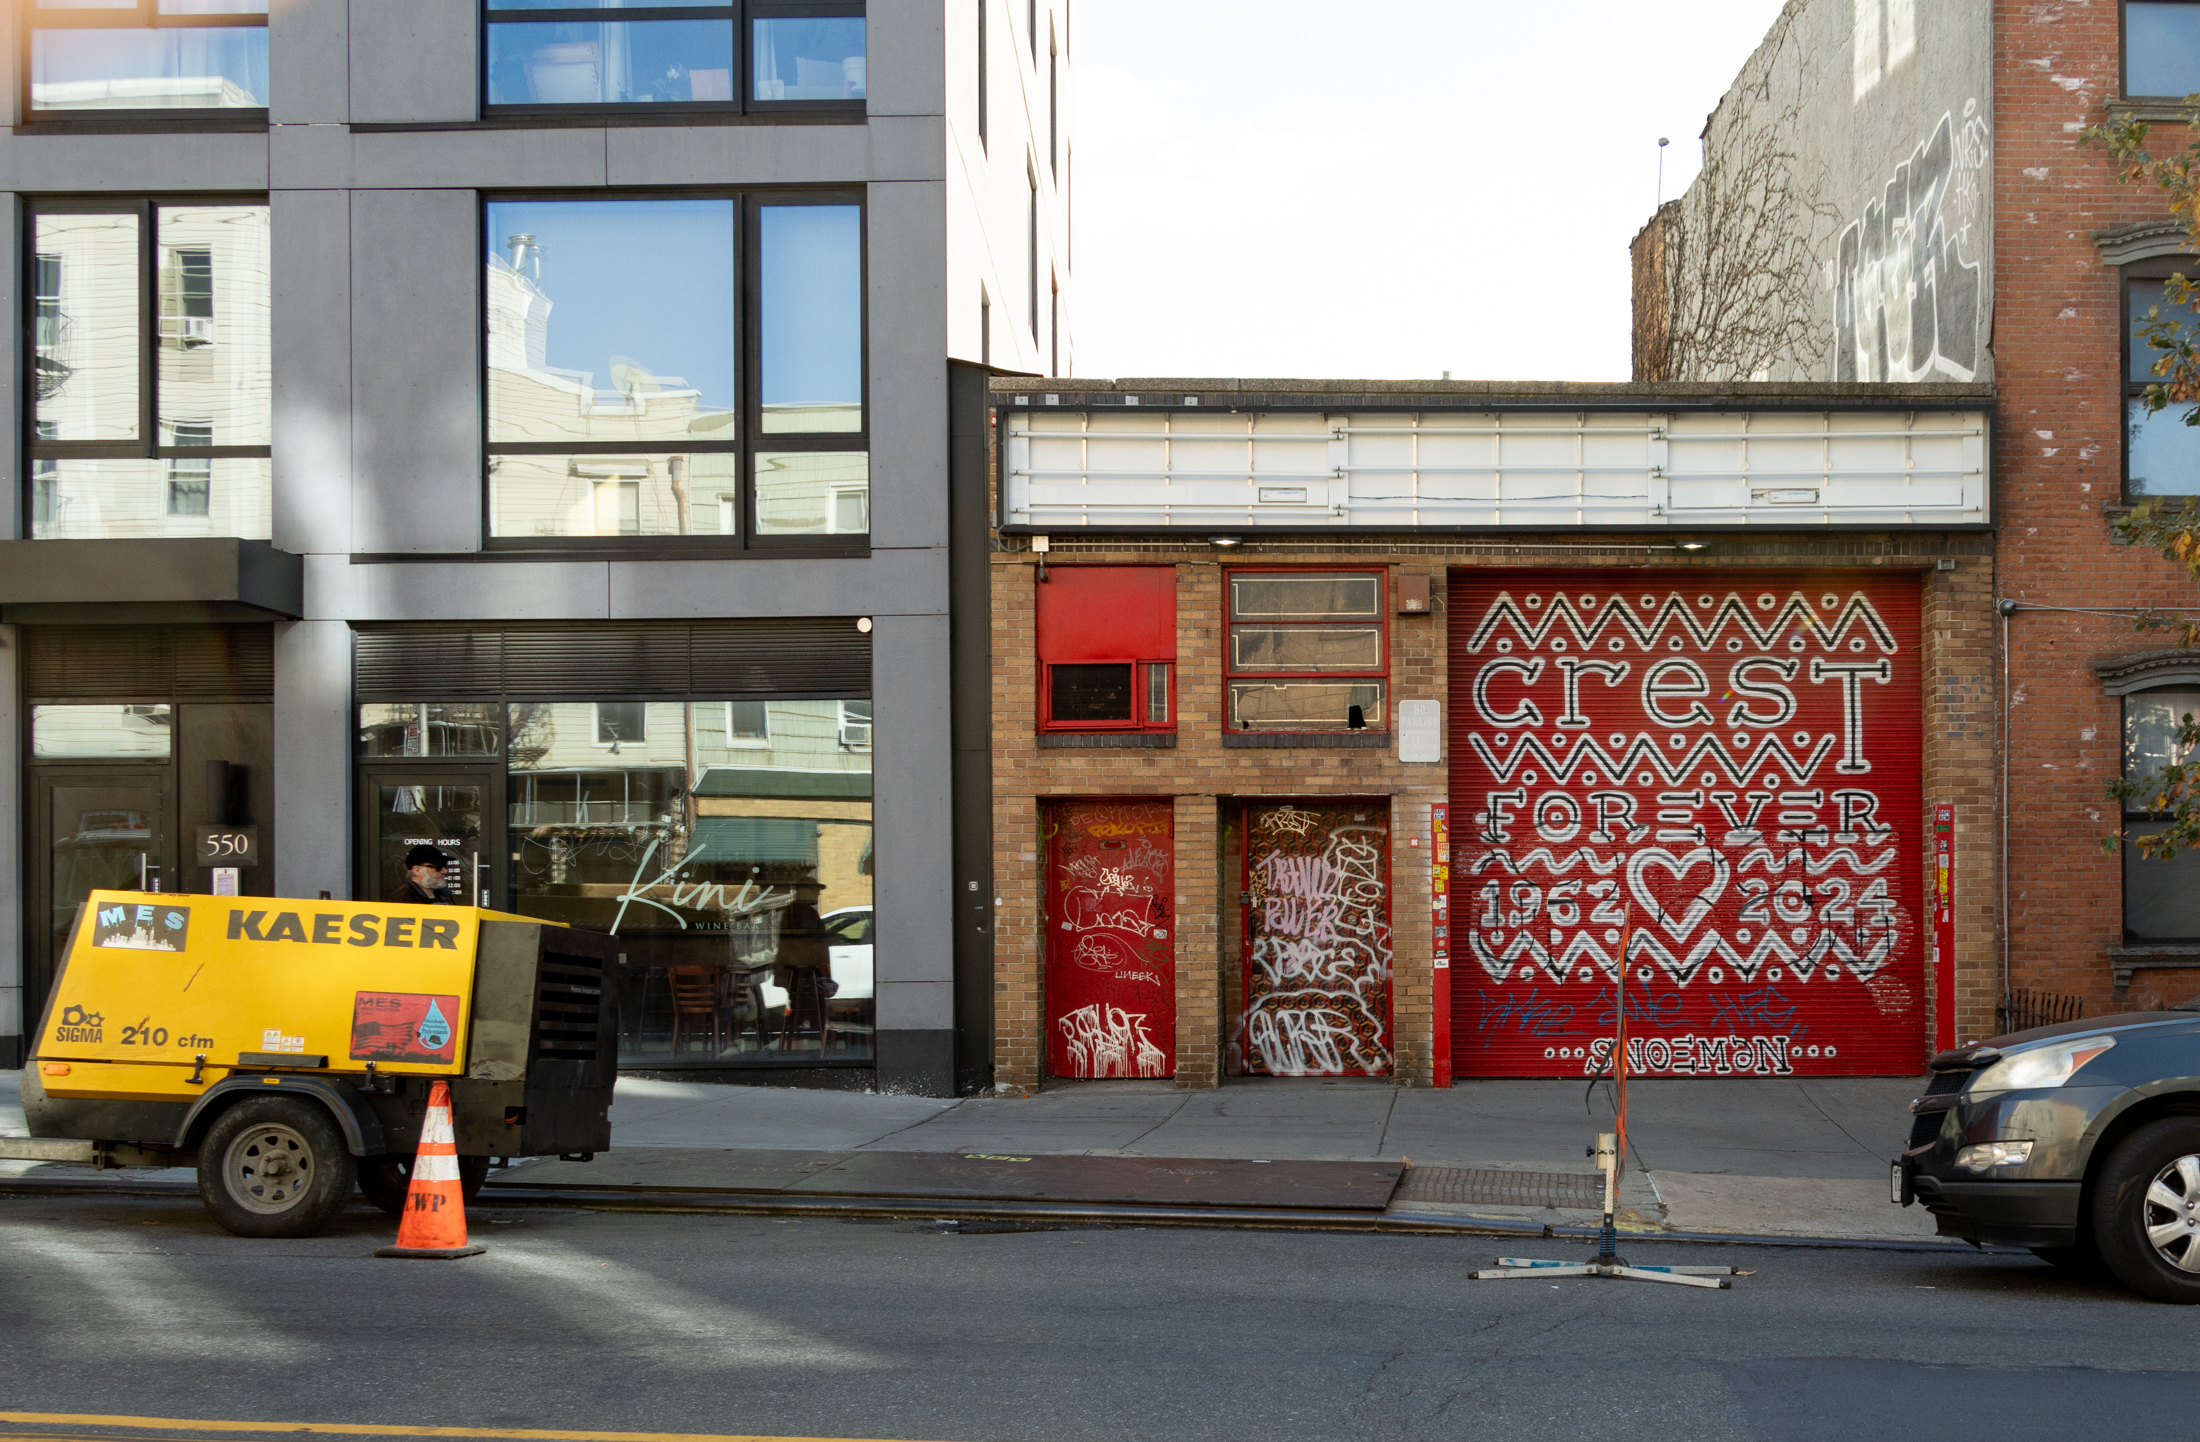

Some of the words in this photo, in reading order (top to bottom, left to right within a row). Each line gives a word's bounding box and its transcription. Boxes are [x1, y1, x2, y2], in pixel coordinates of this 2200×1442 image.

[1413, 704, 1426, 716] NO
[1401, 716, 1438, 728] PARKING
[1475, 788, 1892, 845] FOREVER
[207, 834, 249, 856] 550
[404, 838, 433, 846] OPENING
[437, 838, 461, 846] HOURS
[610, 839, 775, 936] Kini
[1478, 879, 1630, 927] 1962
[1736, 878, 1898, 927] 2024
[226, 909, 460, 950] KAESER
[695, 922, 729, 930] WINE
[736, 922, 760, 930] BAR
[358, 997, 401, 1008] MES
[56, 1027, 103, 1043] SIGMA
[121, 1025, 169, 1046] 210
[177, 1034, 214, 1049] cfm
